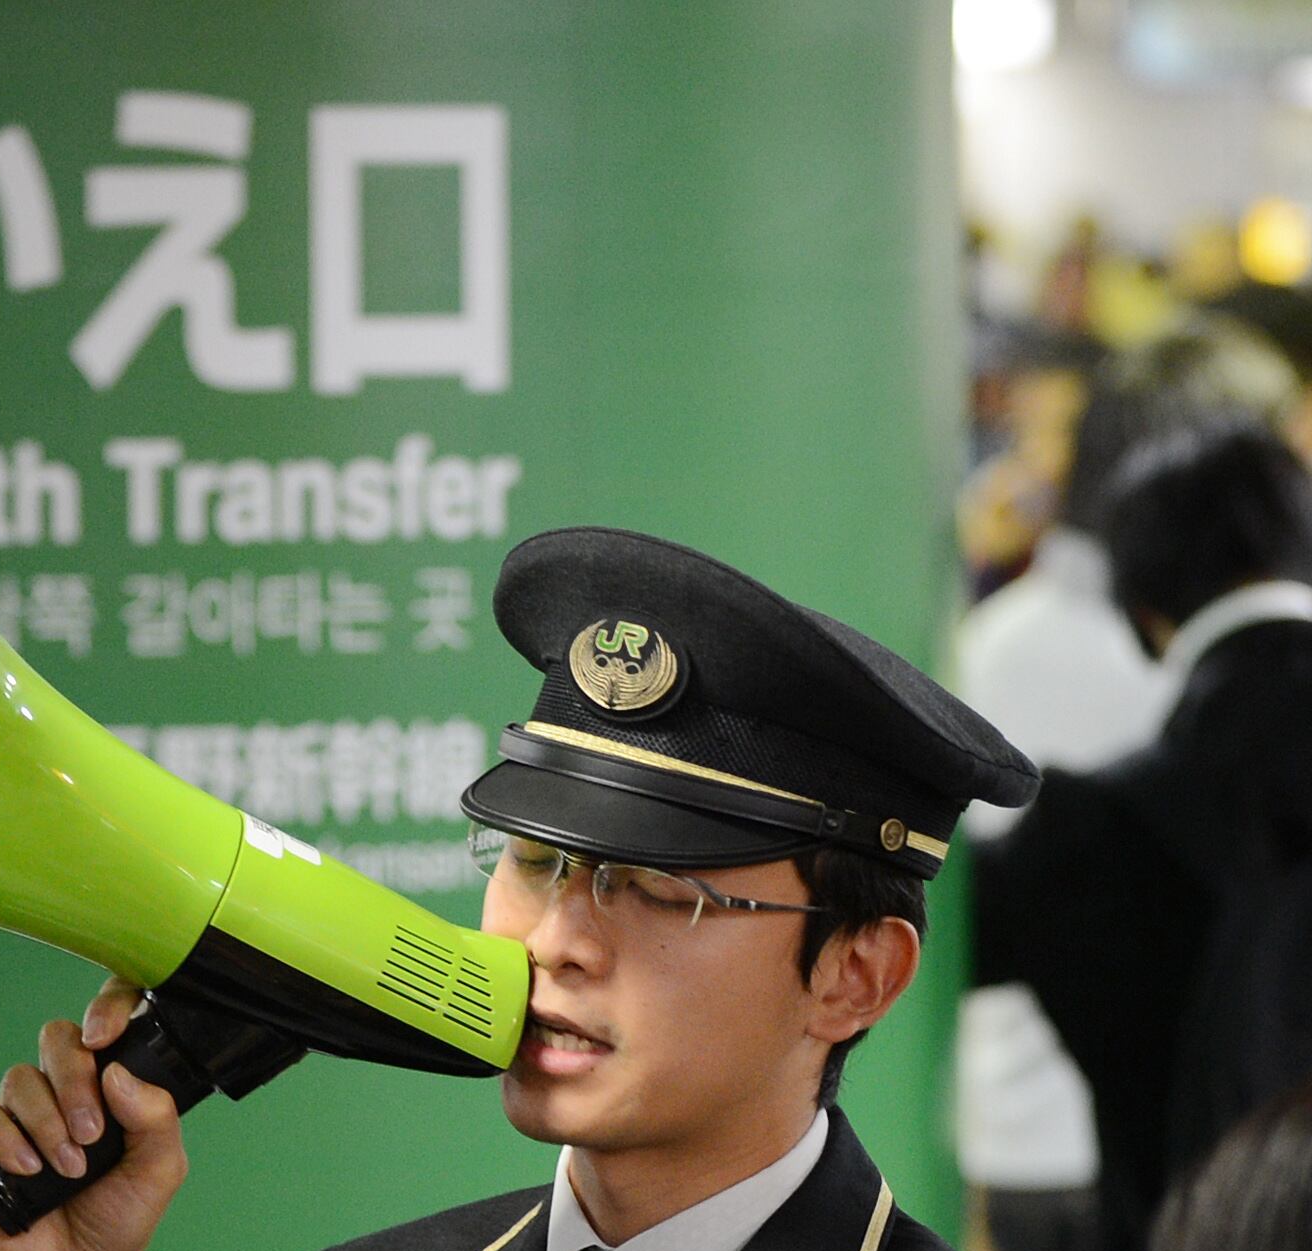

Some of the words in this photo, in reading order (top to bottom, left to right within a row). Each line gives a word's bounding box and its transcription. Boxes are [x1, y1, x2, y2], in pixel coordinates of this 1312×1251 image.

[104, 432, 524, 545] Transfer
[122, 569, 395, 658] 갈아타는
[409, 566, 475, 652] 곳
[595, 619, 650, 658] JR
